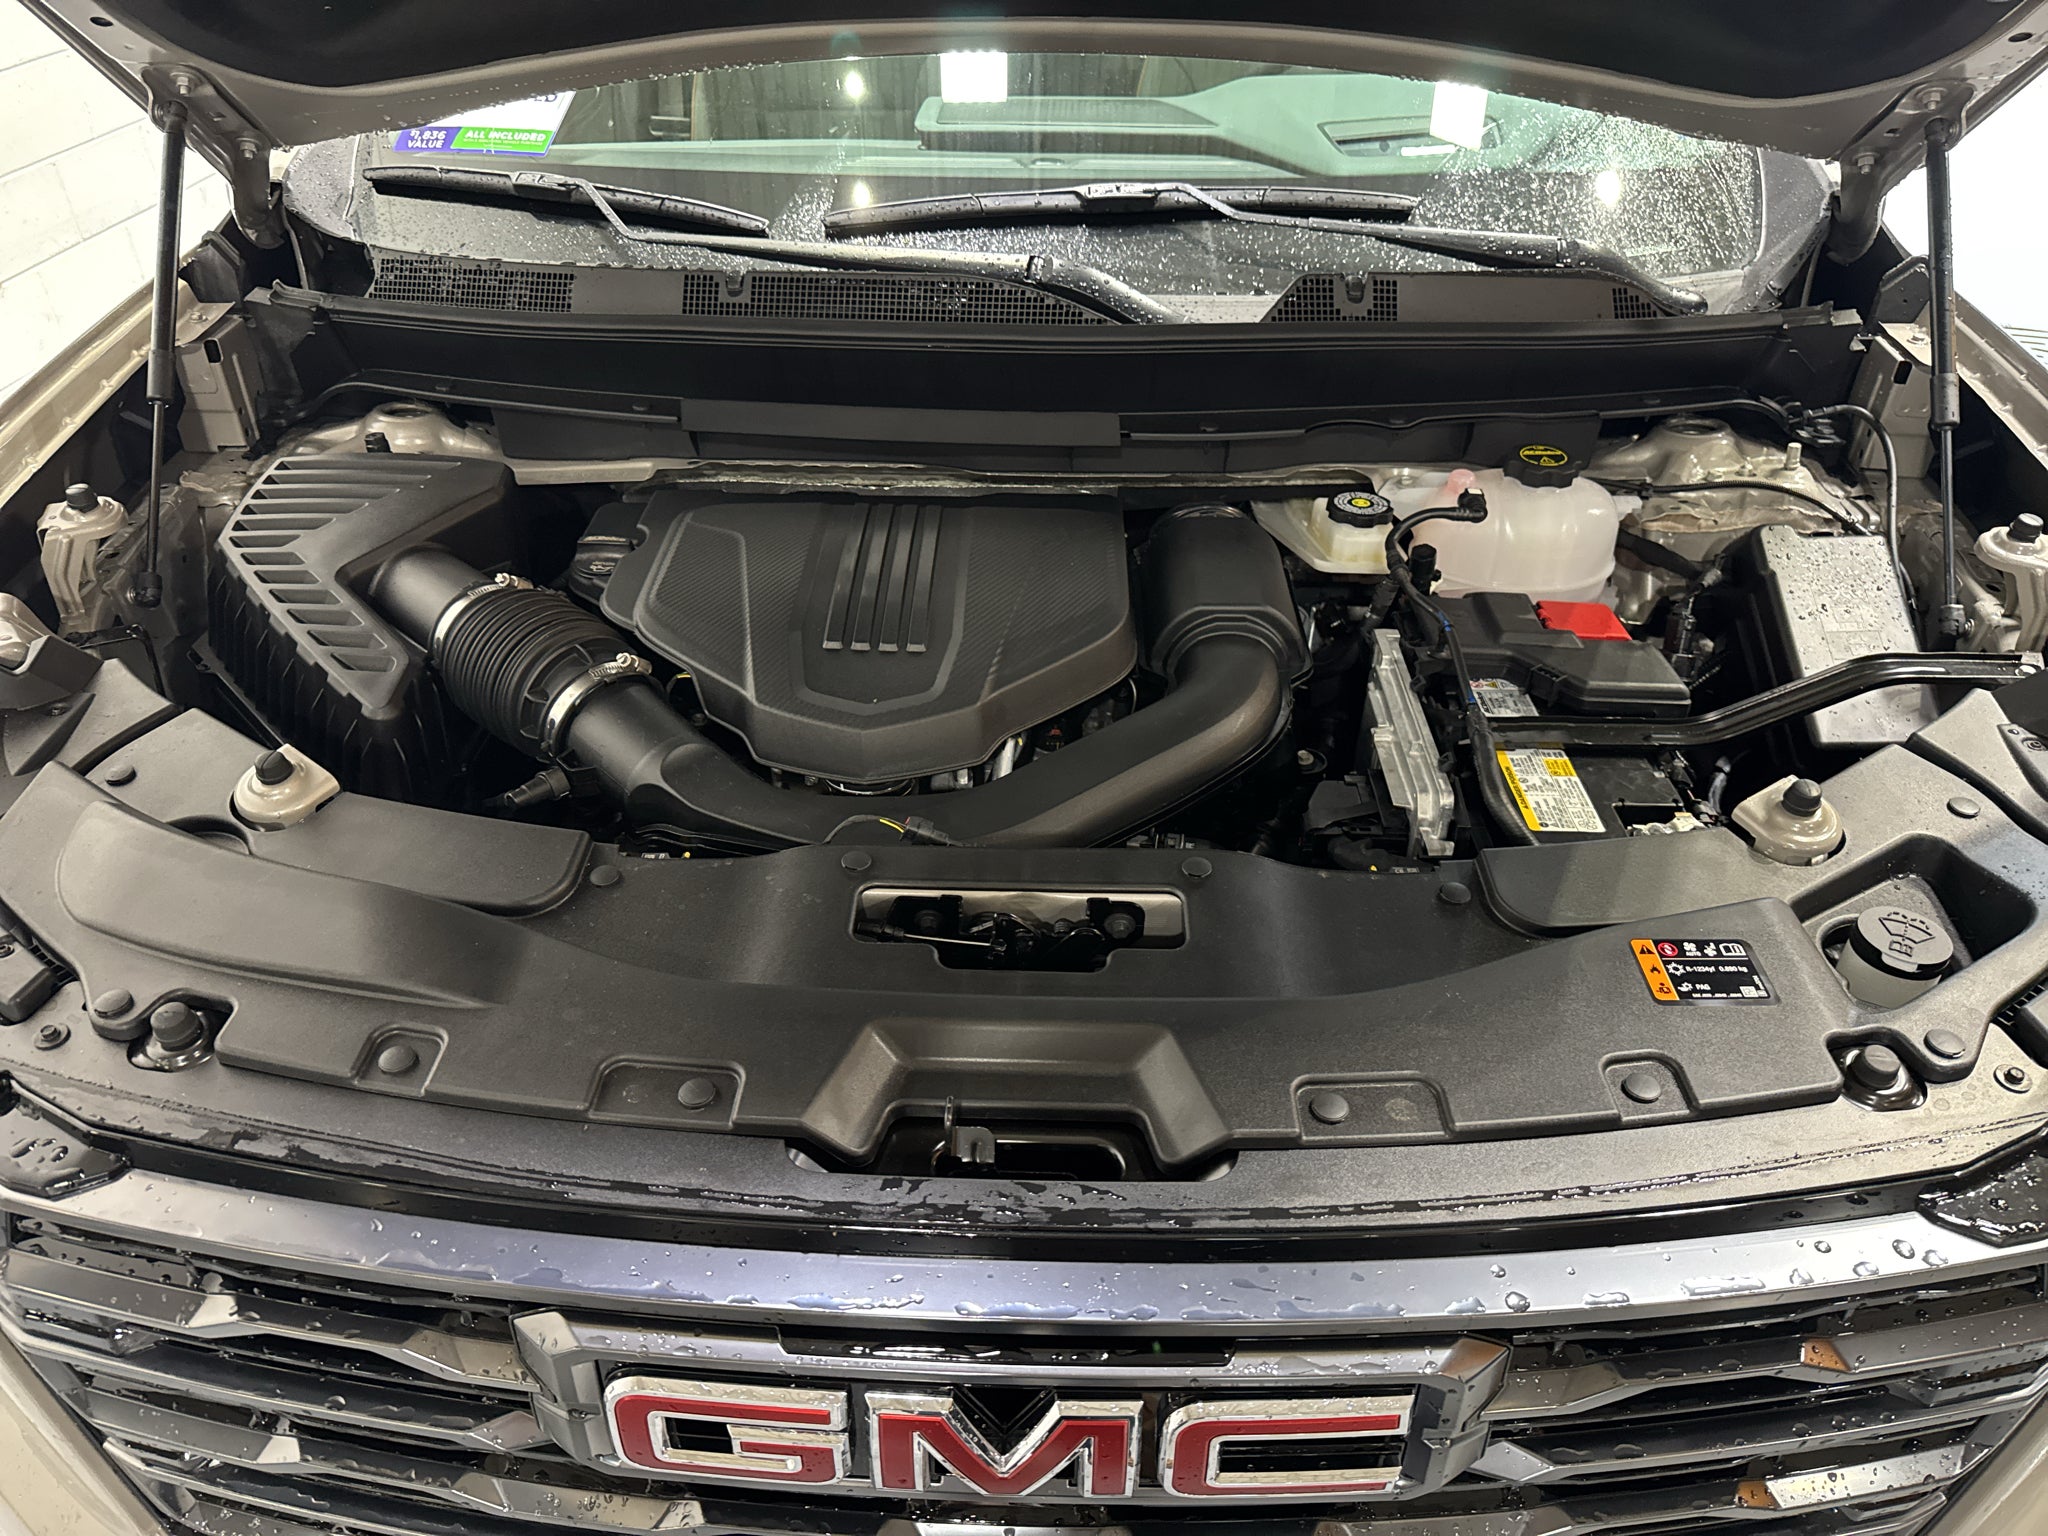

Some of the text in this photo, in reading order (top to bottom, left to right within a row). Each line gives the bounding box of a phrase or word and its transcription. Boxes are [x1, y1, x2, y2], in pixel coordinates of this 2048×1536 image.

[464, 130, 485, 139] ALL
[489, 131, 546, 142] INCLUDED
[408, 139, 444, 148] VALUE
[603, 1373, 1418, 1498] GMC
